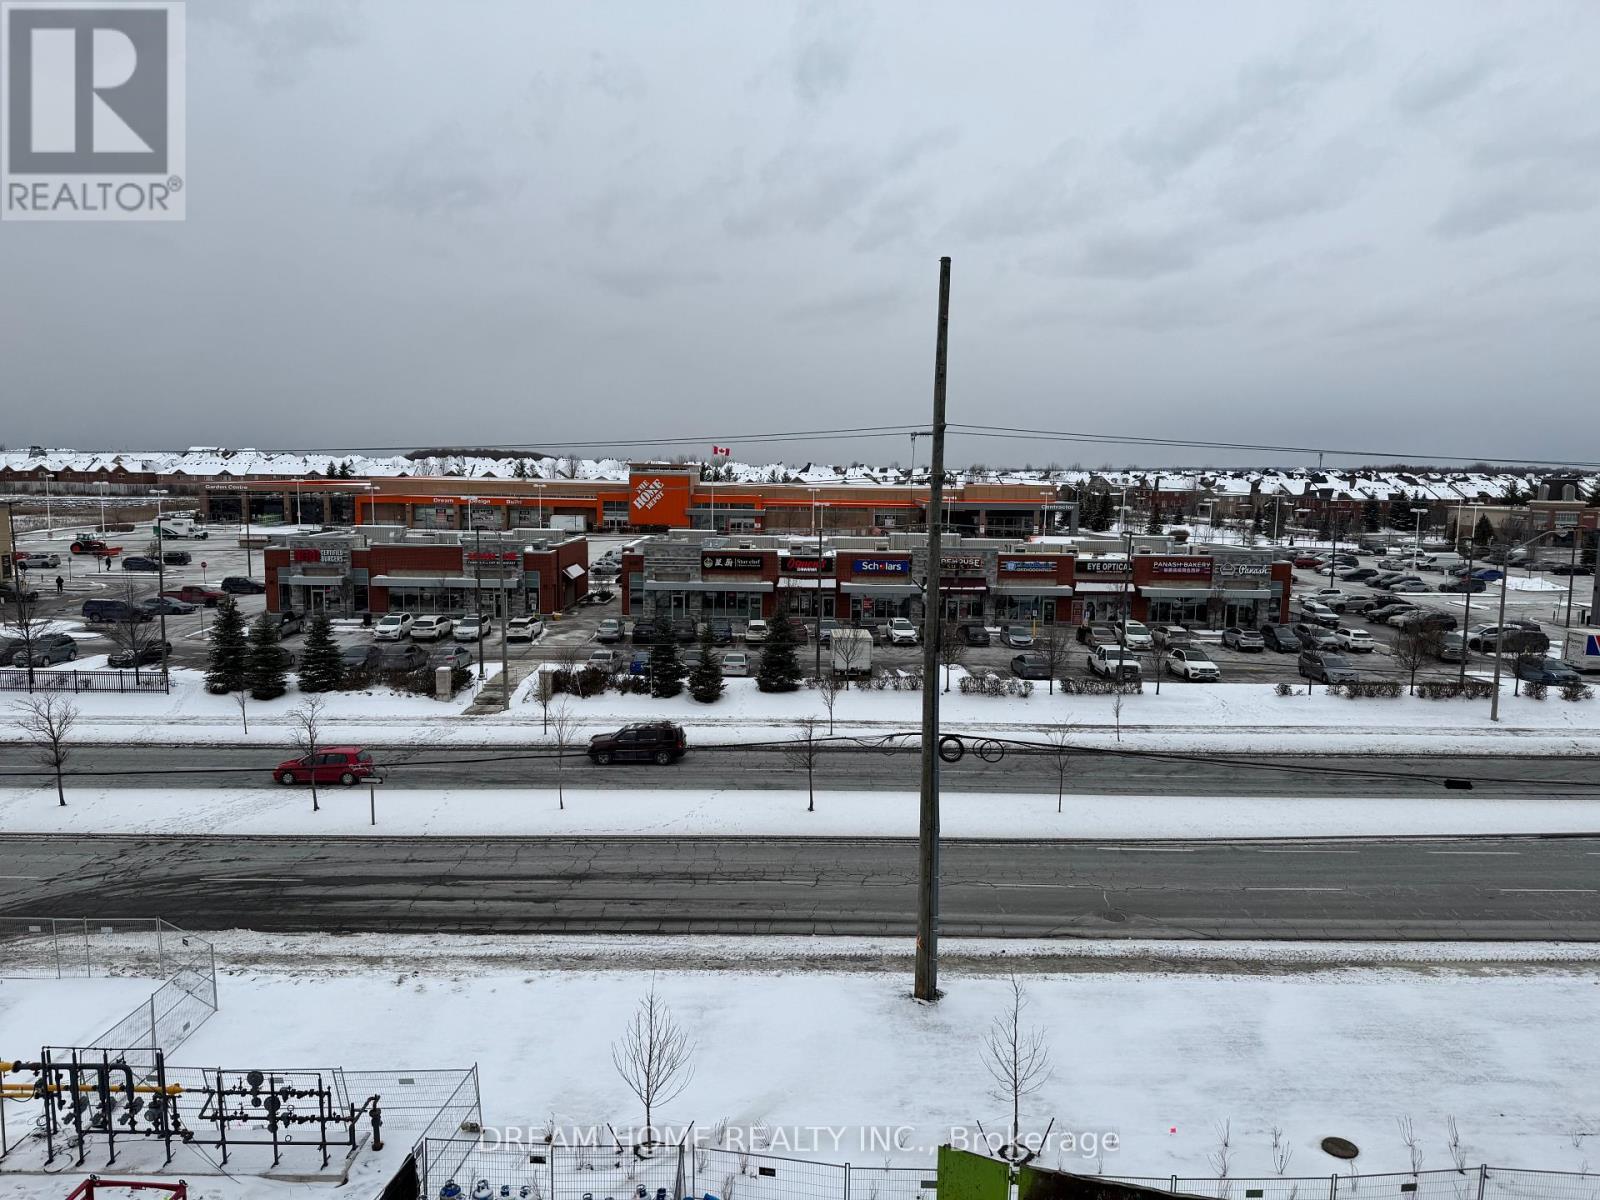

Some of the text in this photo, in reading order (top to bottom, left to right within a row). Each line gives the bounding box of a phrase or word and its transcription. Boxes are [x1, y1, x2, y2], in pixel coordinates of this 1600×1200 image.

[633, 478, 665, 510] HOME
[635, 479, 650, 494] THE
[646, 490, 665, 510] DEPOT
[1087, 562, 1132, 571] EYE OPTICAL
[1238, 563, 1268, 575] Panash
